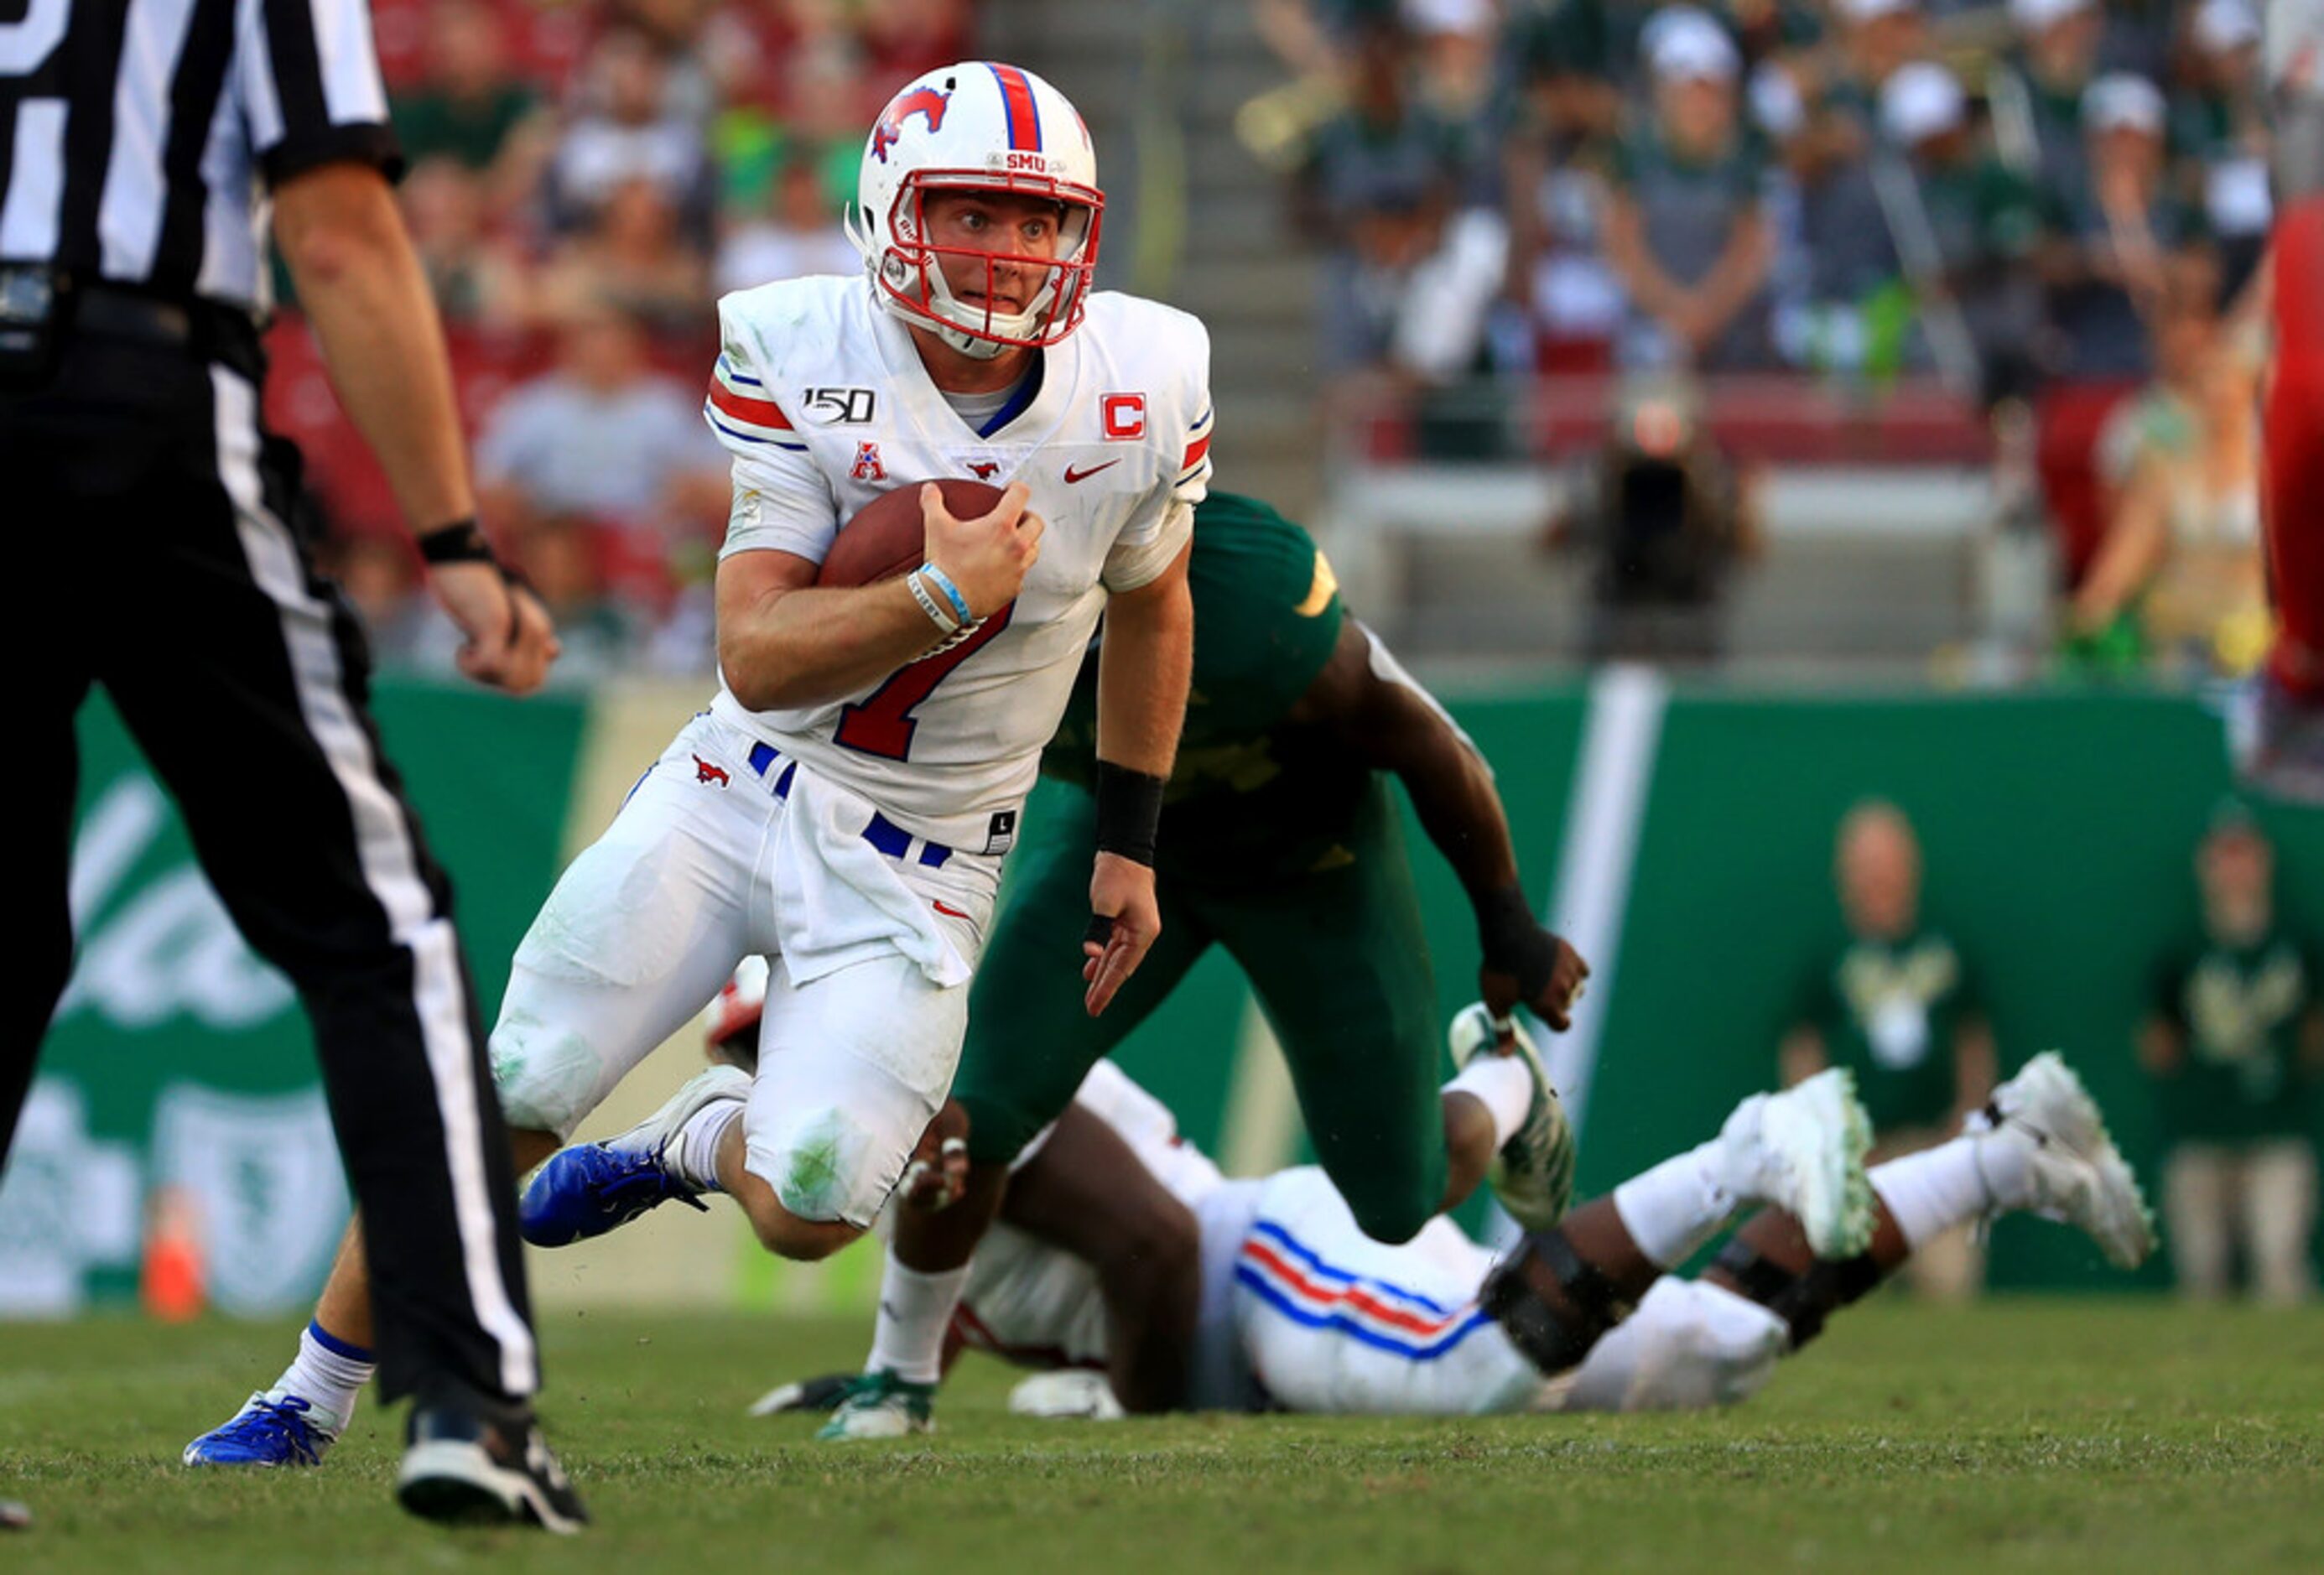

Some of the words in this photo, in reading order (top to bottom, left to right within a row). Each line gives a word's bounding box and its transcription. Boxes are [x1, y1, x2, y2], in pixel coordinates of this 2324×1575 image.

[1006, 153, 1046, 173] SMU
[803, 388, 875, 424] 150
[1105, 396, 1143, 435] C
[833, 599, 1016, 762] 7
